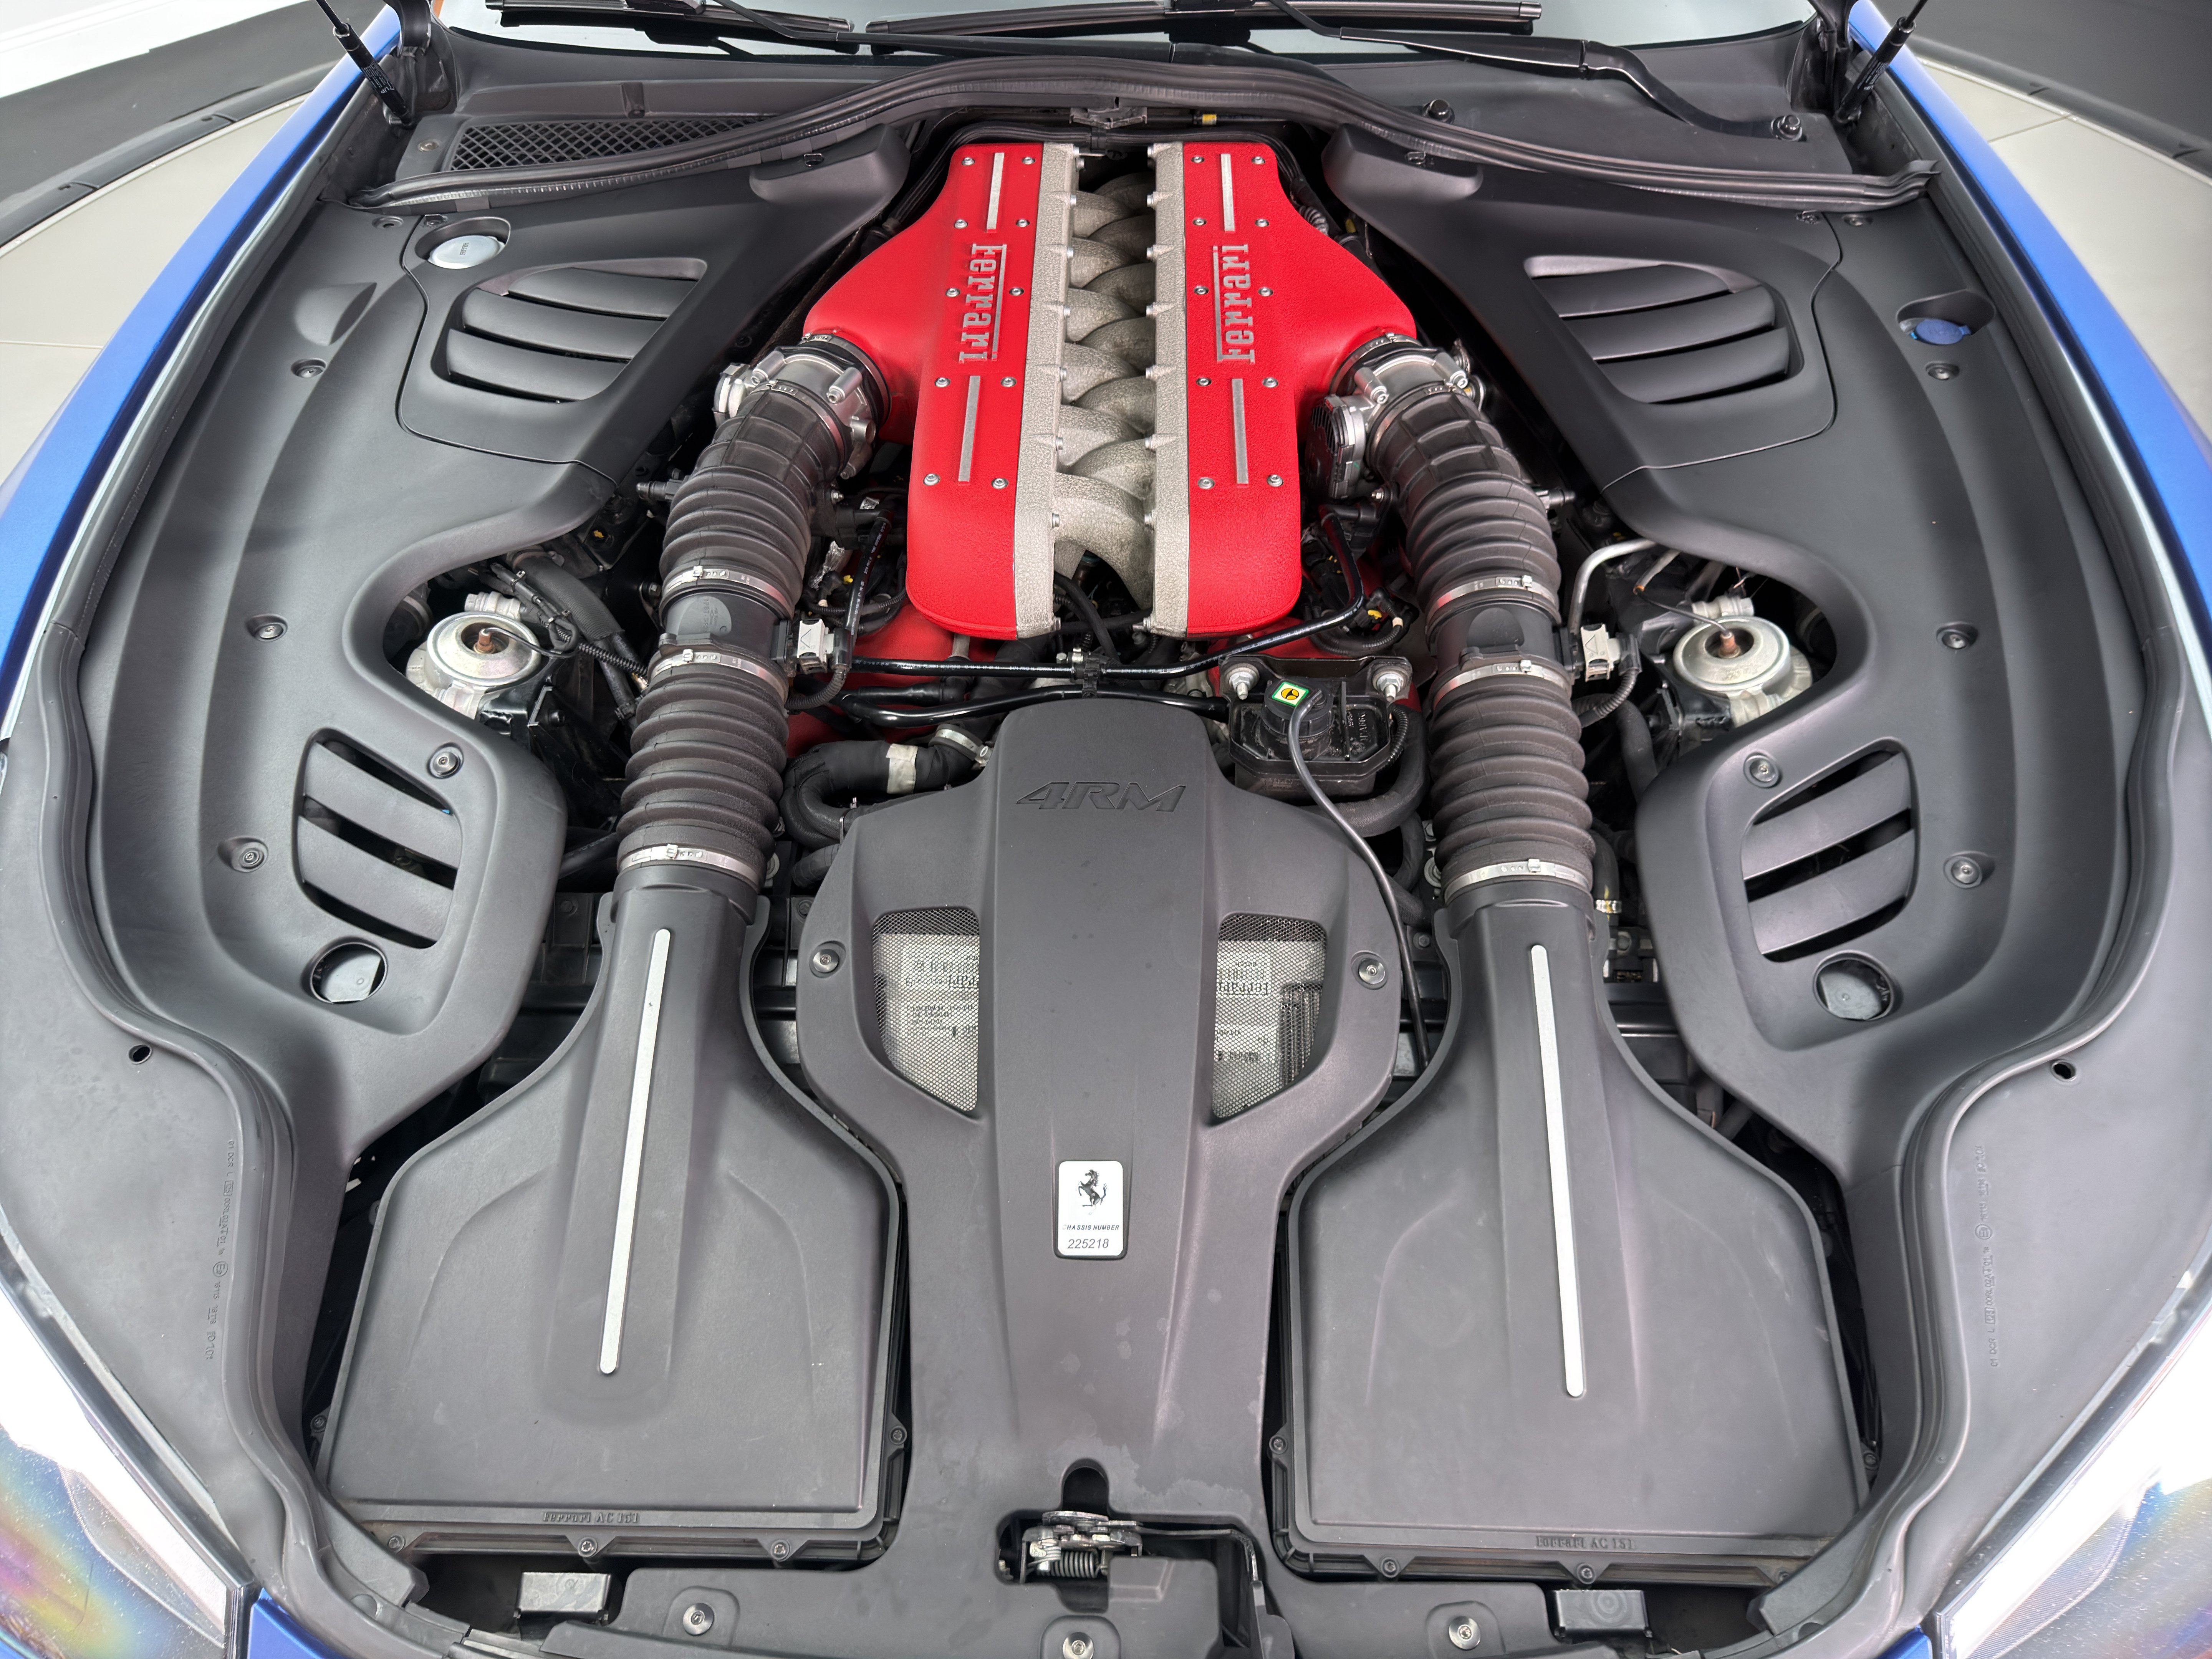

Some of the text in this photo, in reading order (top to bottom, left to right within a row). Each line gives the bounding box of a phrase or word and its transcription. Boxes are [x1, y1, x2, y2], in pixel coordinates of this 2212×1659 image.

[959, 243, 1007, 364] Ferrari
[1213, 244, 1255, 364] Ferrari
[1017, 781, 1186, 812] 4RM
[1068, 1238, 1109, 1249] 225218
[543, 1512, 639, 1523] Ferrari AC 151
[1591, 1538, 1608, 1548] AC
[1613, 1538, 1634, 1549] 151
